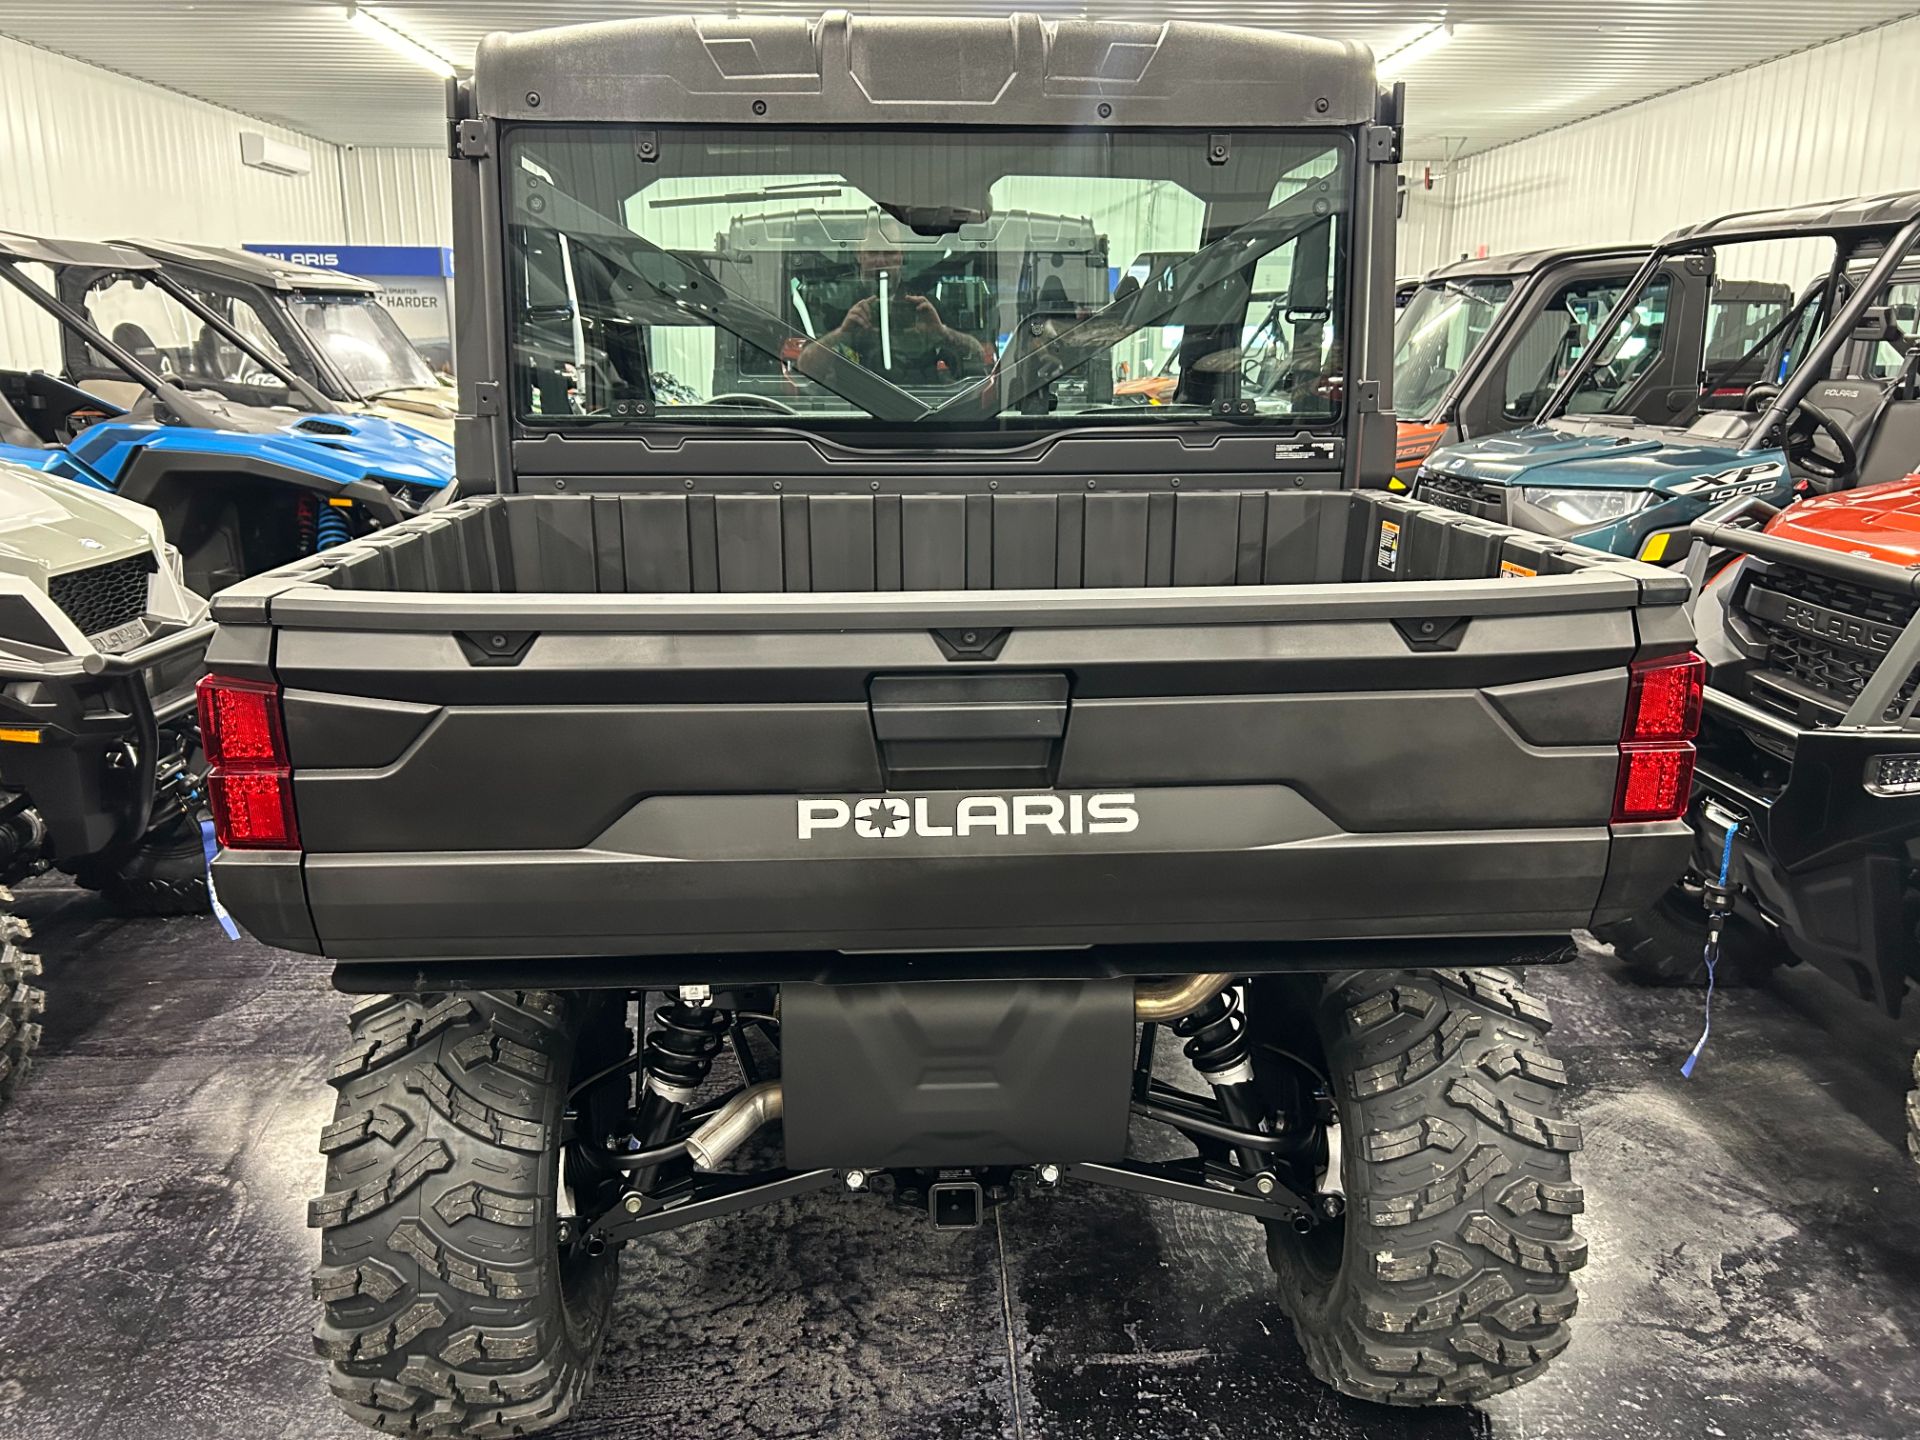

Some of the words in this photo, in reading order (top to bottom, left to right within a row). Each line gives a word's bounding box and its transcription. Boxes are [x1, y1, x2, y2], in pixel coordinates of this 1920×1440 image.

[264, 253, 339, 266] LARIS
[386, 296, 438, 308] HARDER
[1688, 462, 1780, 493] XP
[1708, 480, 1777, 501] 1000
[90, 623, 147, 652] OLARIS
[1782, 603, 1893, 652] POLARIS
[797, 793, 1140, 839] POLARIS
